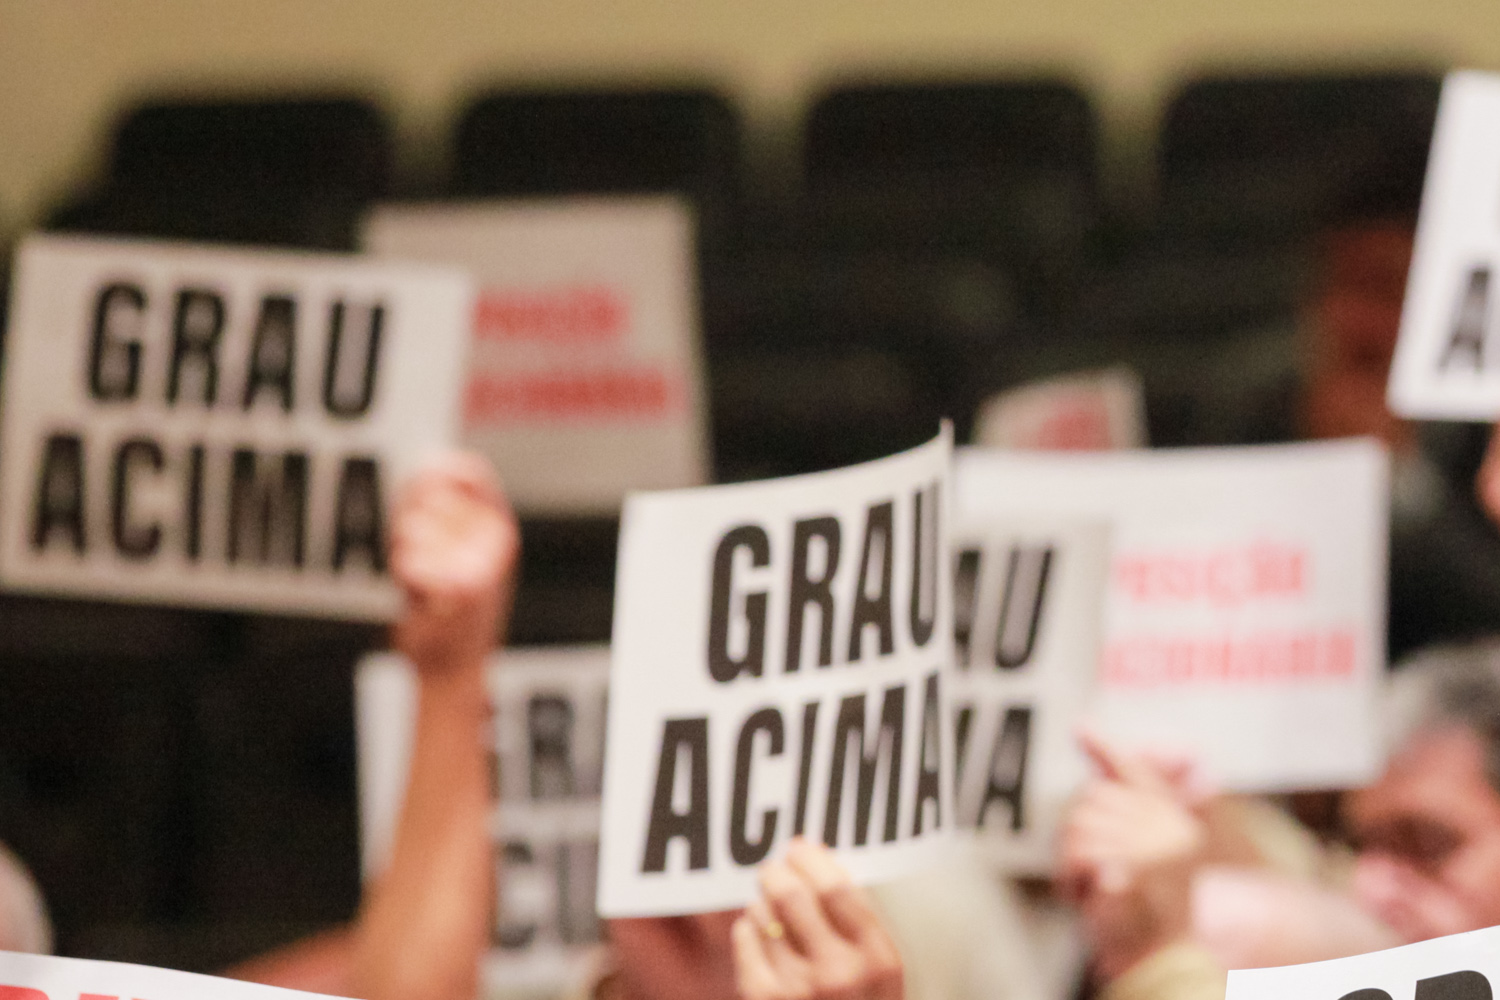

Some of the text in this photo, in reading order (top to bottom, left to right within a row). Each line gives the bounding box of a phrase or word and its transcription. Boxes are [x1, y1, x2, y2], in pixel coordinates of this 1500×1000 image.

[87, 282, 389, 420] GRAU
[28, 432, 392, 576] ACIMA
[706, 478, 940, 684] GRAU
[639, 674, 943, 875] ACIMA
